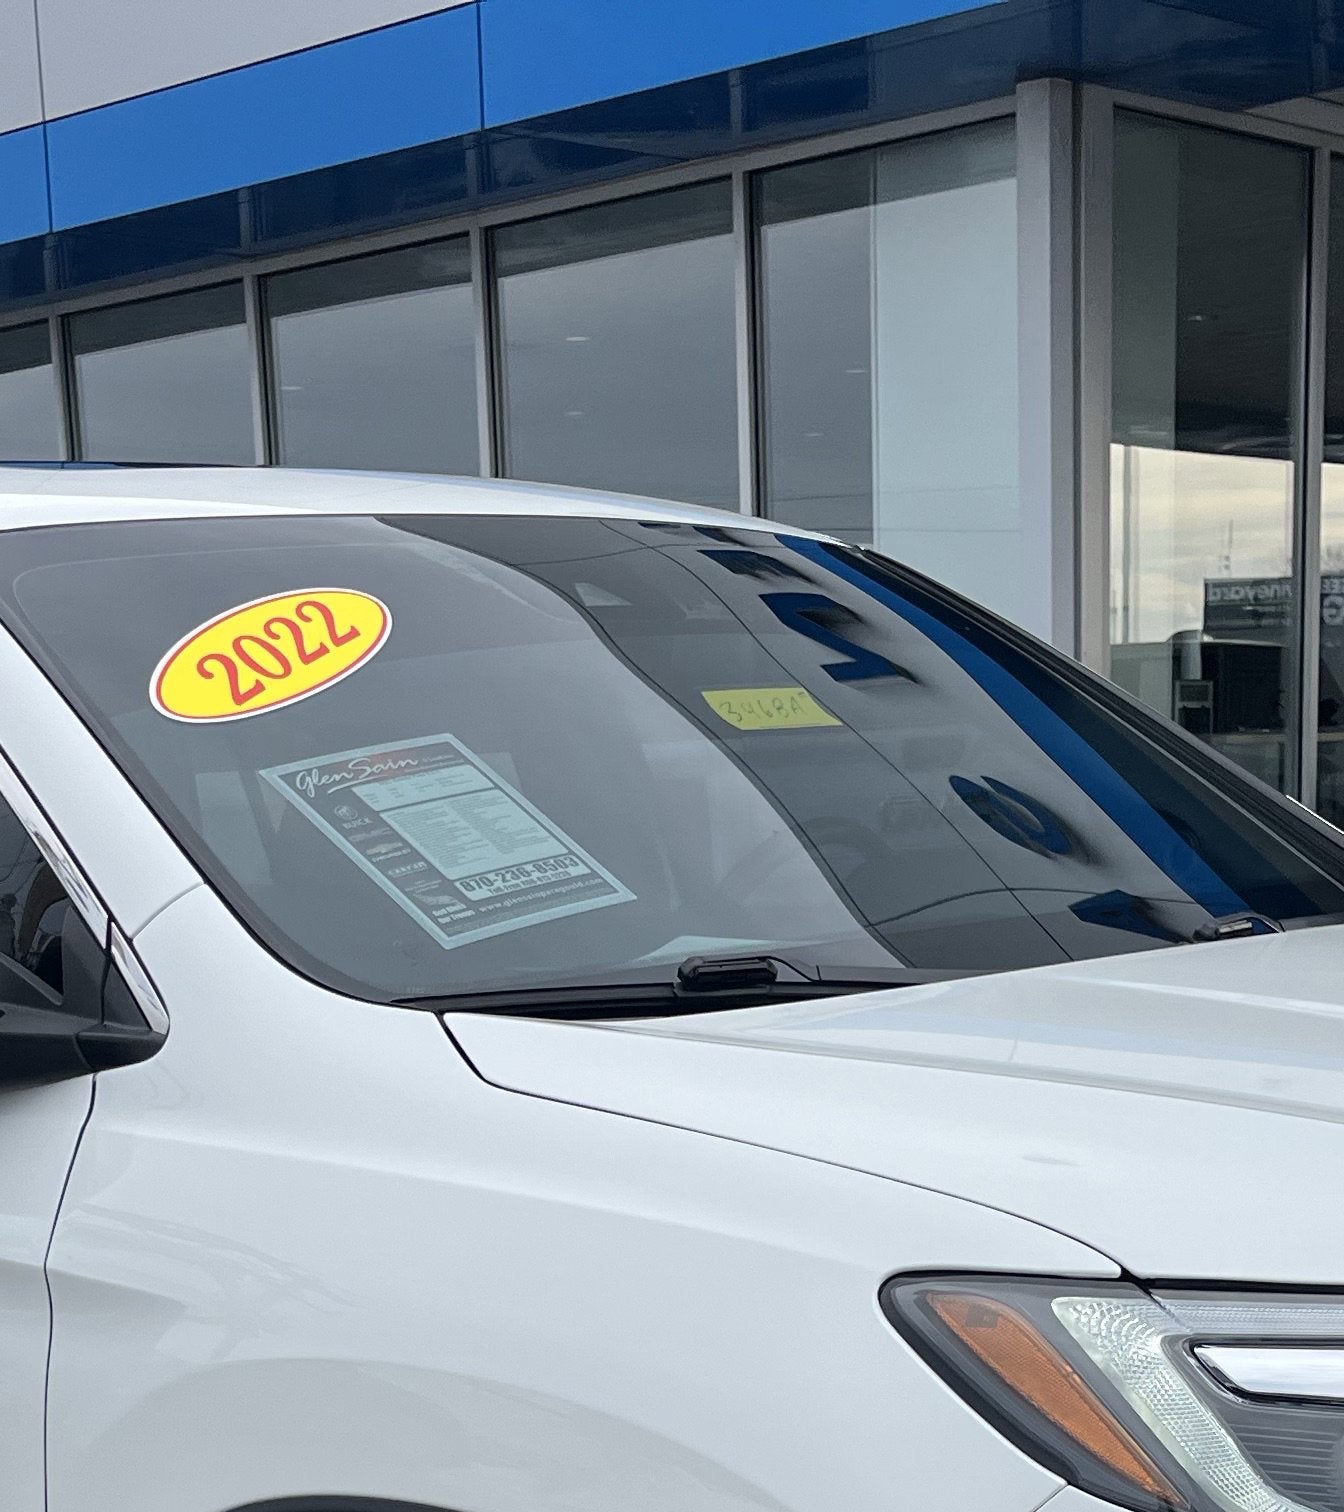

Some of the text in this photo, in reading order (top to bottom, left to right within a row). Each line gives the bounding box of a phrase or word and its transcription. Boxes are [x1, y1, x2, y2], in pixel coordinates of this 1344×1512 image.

[197, 601, 361, 705] 2022
[295, 769, 353, 798] Glen
[348, 758, 418, 778] Sain
[459, 856, 579, 892] 870-236-8503
